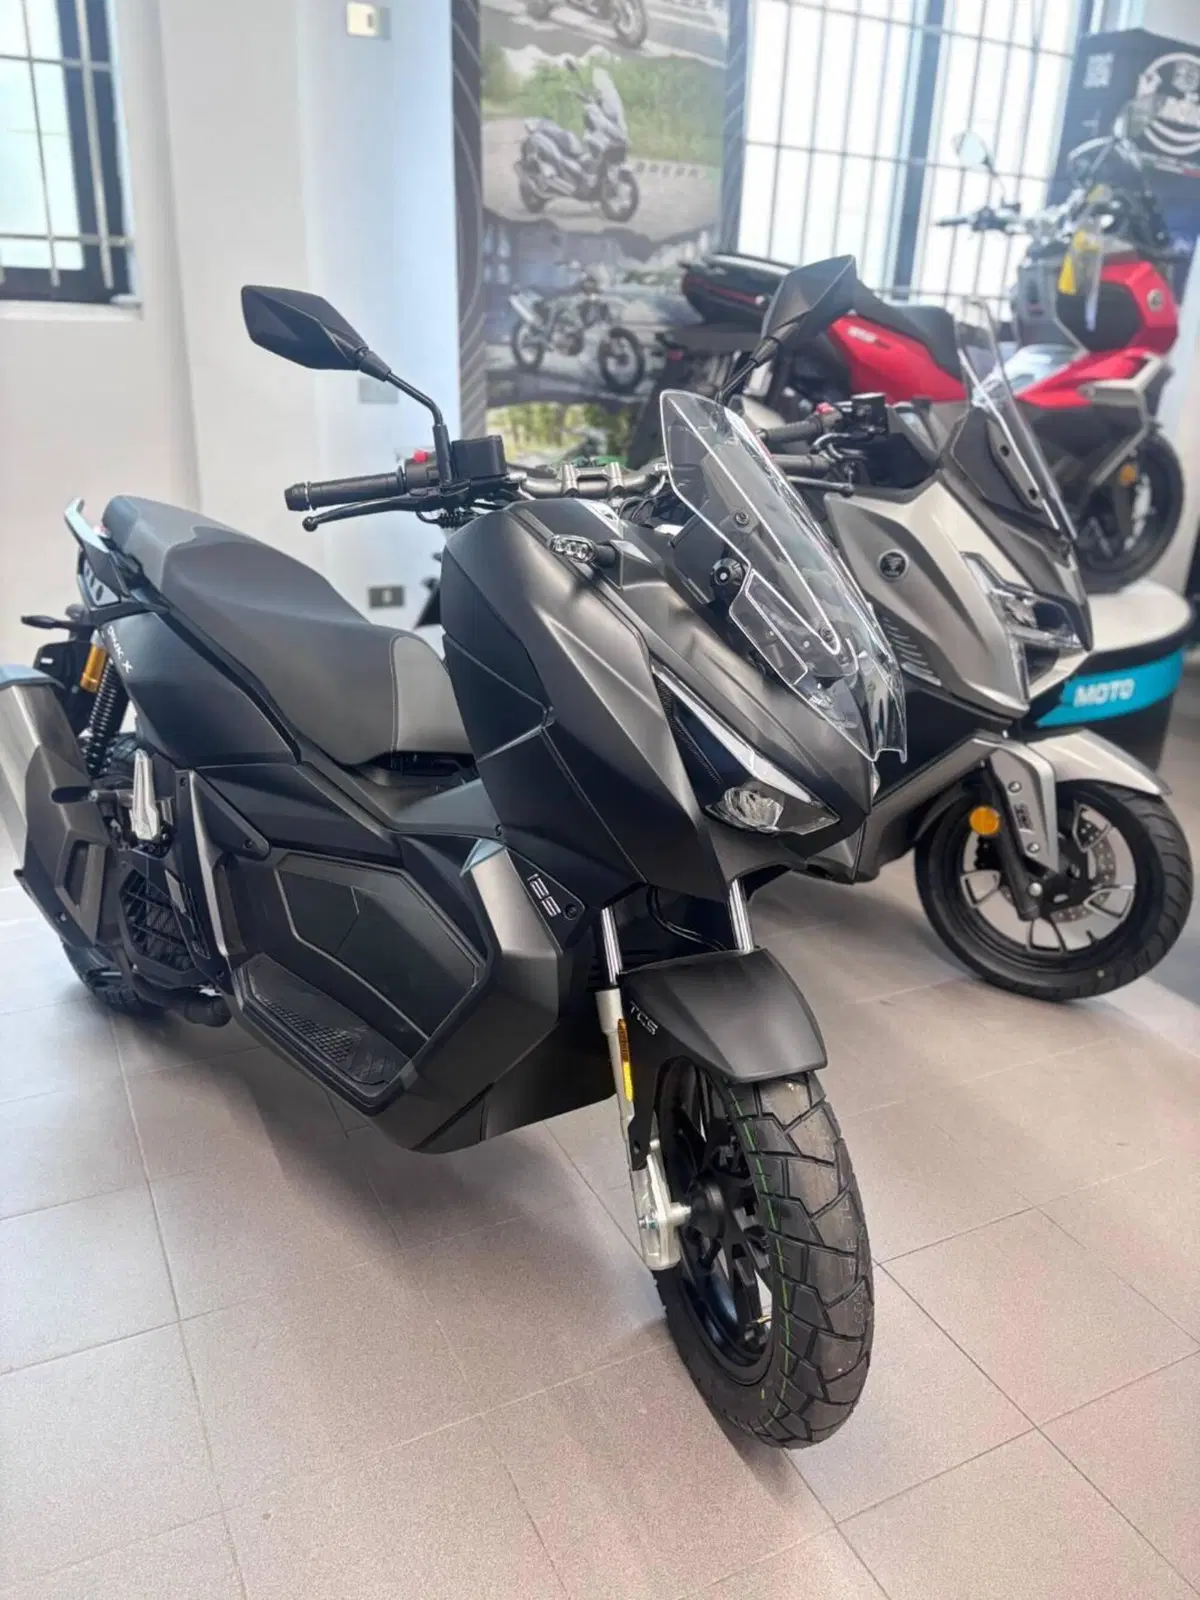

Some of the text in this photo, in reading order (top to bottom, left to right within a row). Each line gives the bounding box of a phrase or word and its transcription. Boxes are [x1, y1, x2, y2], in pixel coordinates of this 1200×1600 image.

[1073, 678, 1136, 707] MOTO
[527, 873, 562, 917] 125
[629, 1000, 659, 1036] TCS
